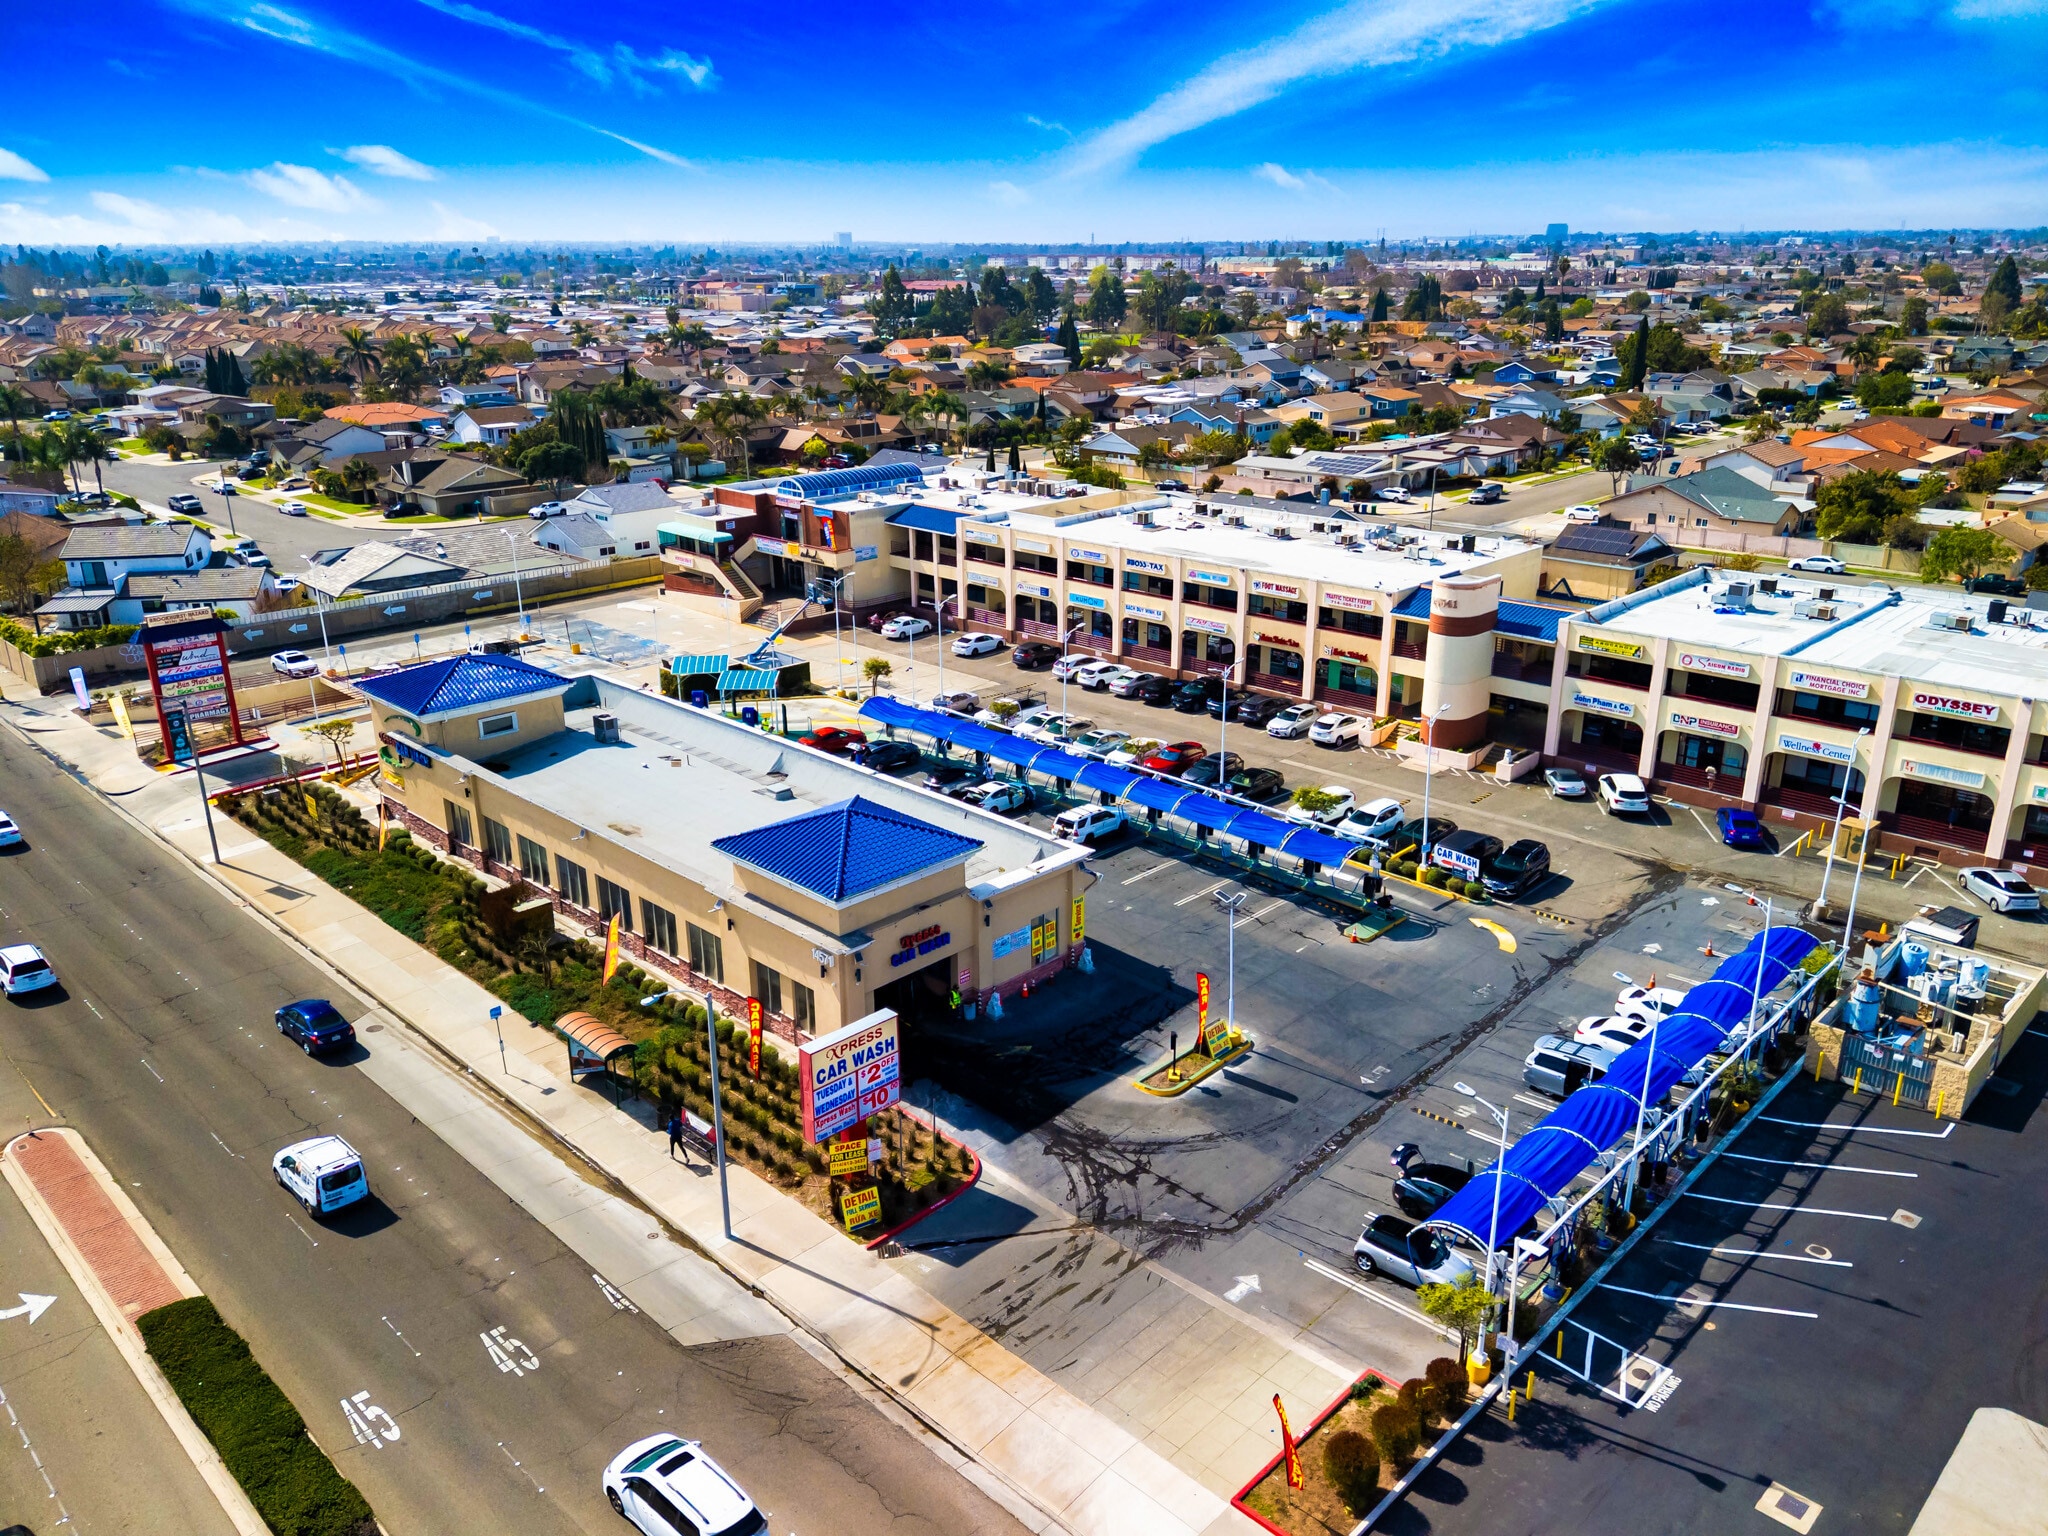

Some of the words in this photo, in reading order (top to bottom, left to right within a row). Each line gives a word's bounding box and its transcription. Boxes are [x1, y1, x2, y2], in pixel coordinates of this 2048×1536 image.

[1262, 582, 1274, 590] FOOT
[1275, 584, 1298, 594] MASSAGE
[165, 669, 217, 682] KUMON
[1806, 674, 1839, 686] FINANCIAL
[1842, 681, 1866, 690] CHOICE
[1809, 683, 1845, 693] MORTGAGE
[1574, 694, 1591, 703] John
[1592, 698, 1612, 708] Pham
[1620, 703, 1631, 711] Co.
[1915, 695, 1996, 715] ODYSSEY
[1934, 706, 1973, 716] INSURANCE
[190, 707, 229, 720] PHARMACY
[1673, 714, 1697, 725] DNP
[1700, 719, 1736, 730] INSURANCE
[1783, 740, 1820, 754] Wellness
[1823, 748, 1852, 760] Center
[1918, 764, 1952, 780] DENTAL
[1952, 770, 1982, 785] GROUP
[1437, 847, 1453, 860] CAR
[1455, 853, 1477, 868] WASH
[891, 948, 916, 967] CAR
[918, 932, 950, 955] WASH
[826, 1028, 883, 1060] XPRESS
[816, 1059, 847, 1084] CAR
[852, 1036, 895, 1067] WASH
[881, 1056, 895, 1068] OFF
[816, 1077, 846, 1101] TUESDAY
[848, 1077, 853, 1086] &
[815, 1088, 855, 1116] WEDNESDAY
[815, 1113, 837, 1129] Xpress
[838, 1104, 856, 1117] Wash
[830, 1151, 845, 1162] FOR
[845, 1149, 866, 1160] LEASE
[834, 1141, 861, 1153] SPACE
[844, 1189, 877, 1208] DETAIL
[846, 1208, 858, 1216] FULL
[858, 1201, 878, 1212] SERVICE
[868, 1210, 879, 1219] XE
[479, 1325, 540, 1377] 45
[1652, 1375, 1682, 1404] PARKING
[1644, 1400, 1661, 1413] NO
[340, 1390, 401, 1450] 45
